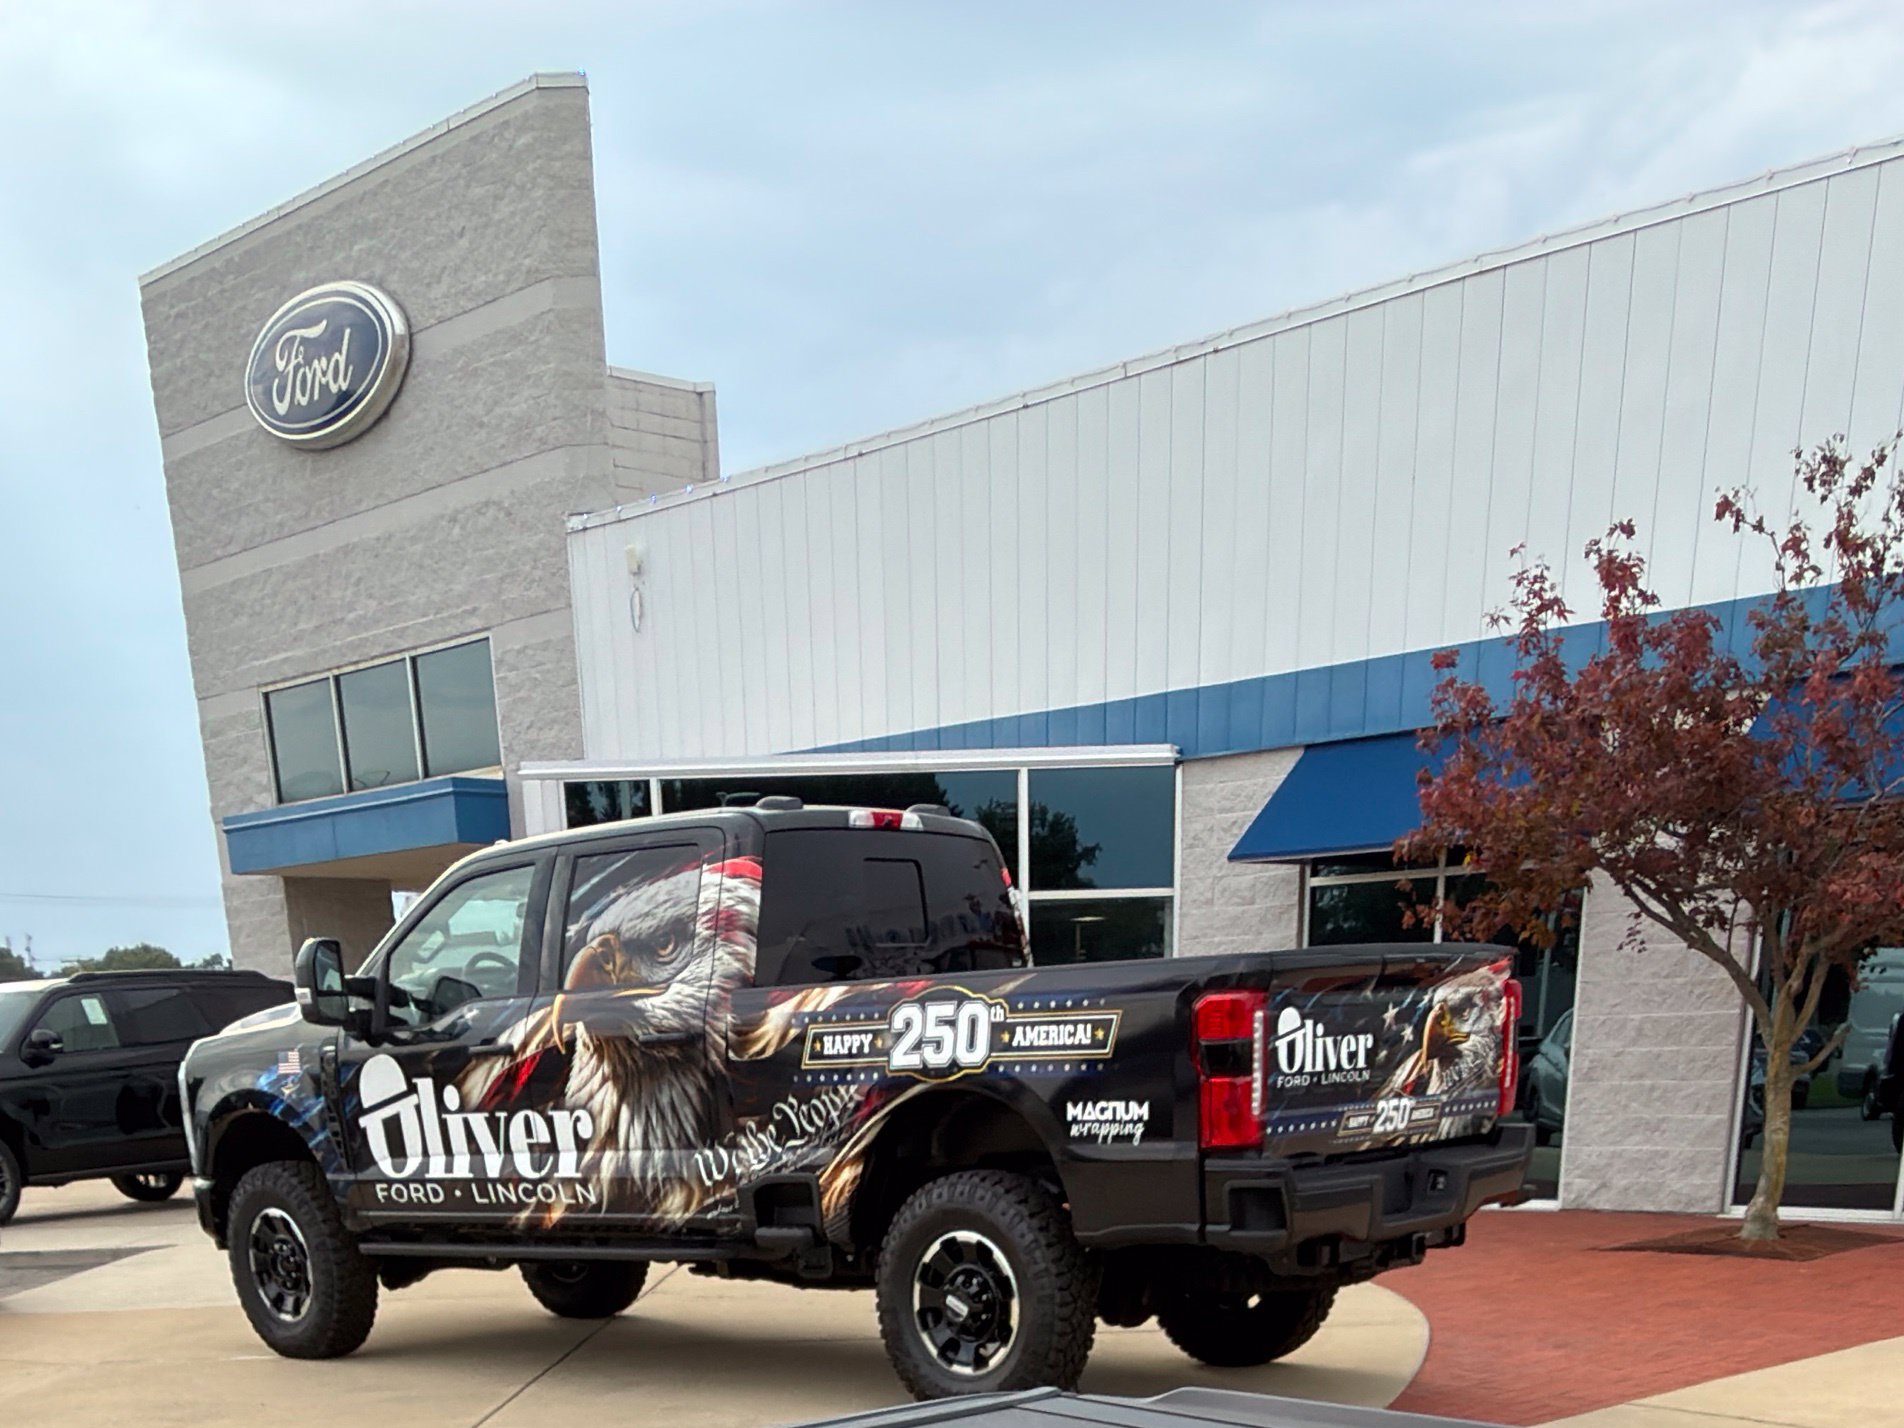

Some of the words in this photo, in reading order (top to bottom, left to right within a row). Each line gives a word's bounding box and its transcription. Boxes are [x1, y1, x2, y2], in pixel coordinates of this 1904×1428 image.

[272, 319, 354, 416] Ford
[822, 1033, 874, 1055] HAPPY
[1011, 1022, 1092, 1048] AMERICA!
[1274, 1006, 1373, 1074] Oliver
[1277, 1075, 1311, 1089] FORD
[1320, 1069, 1371, 1086] LINCOLN
[358, 1053, 594, 1179] Oliver
[1066, 1100, 1151, 1122] MAGNUM
[1069, 1121, 1146, 1147] wrapping
[375, 1182, 445, 1204] FORD
[470, 1181, 598, 1205] LINCOLN
